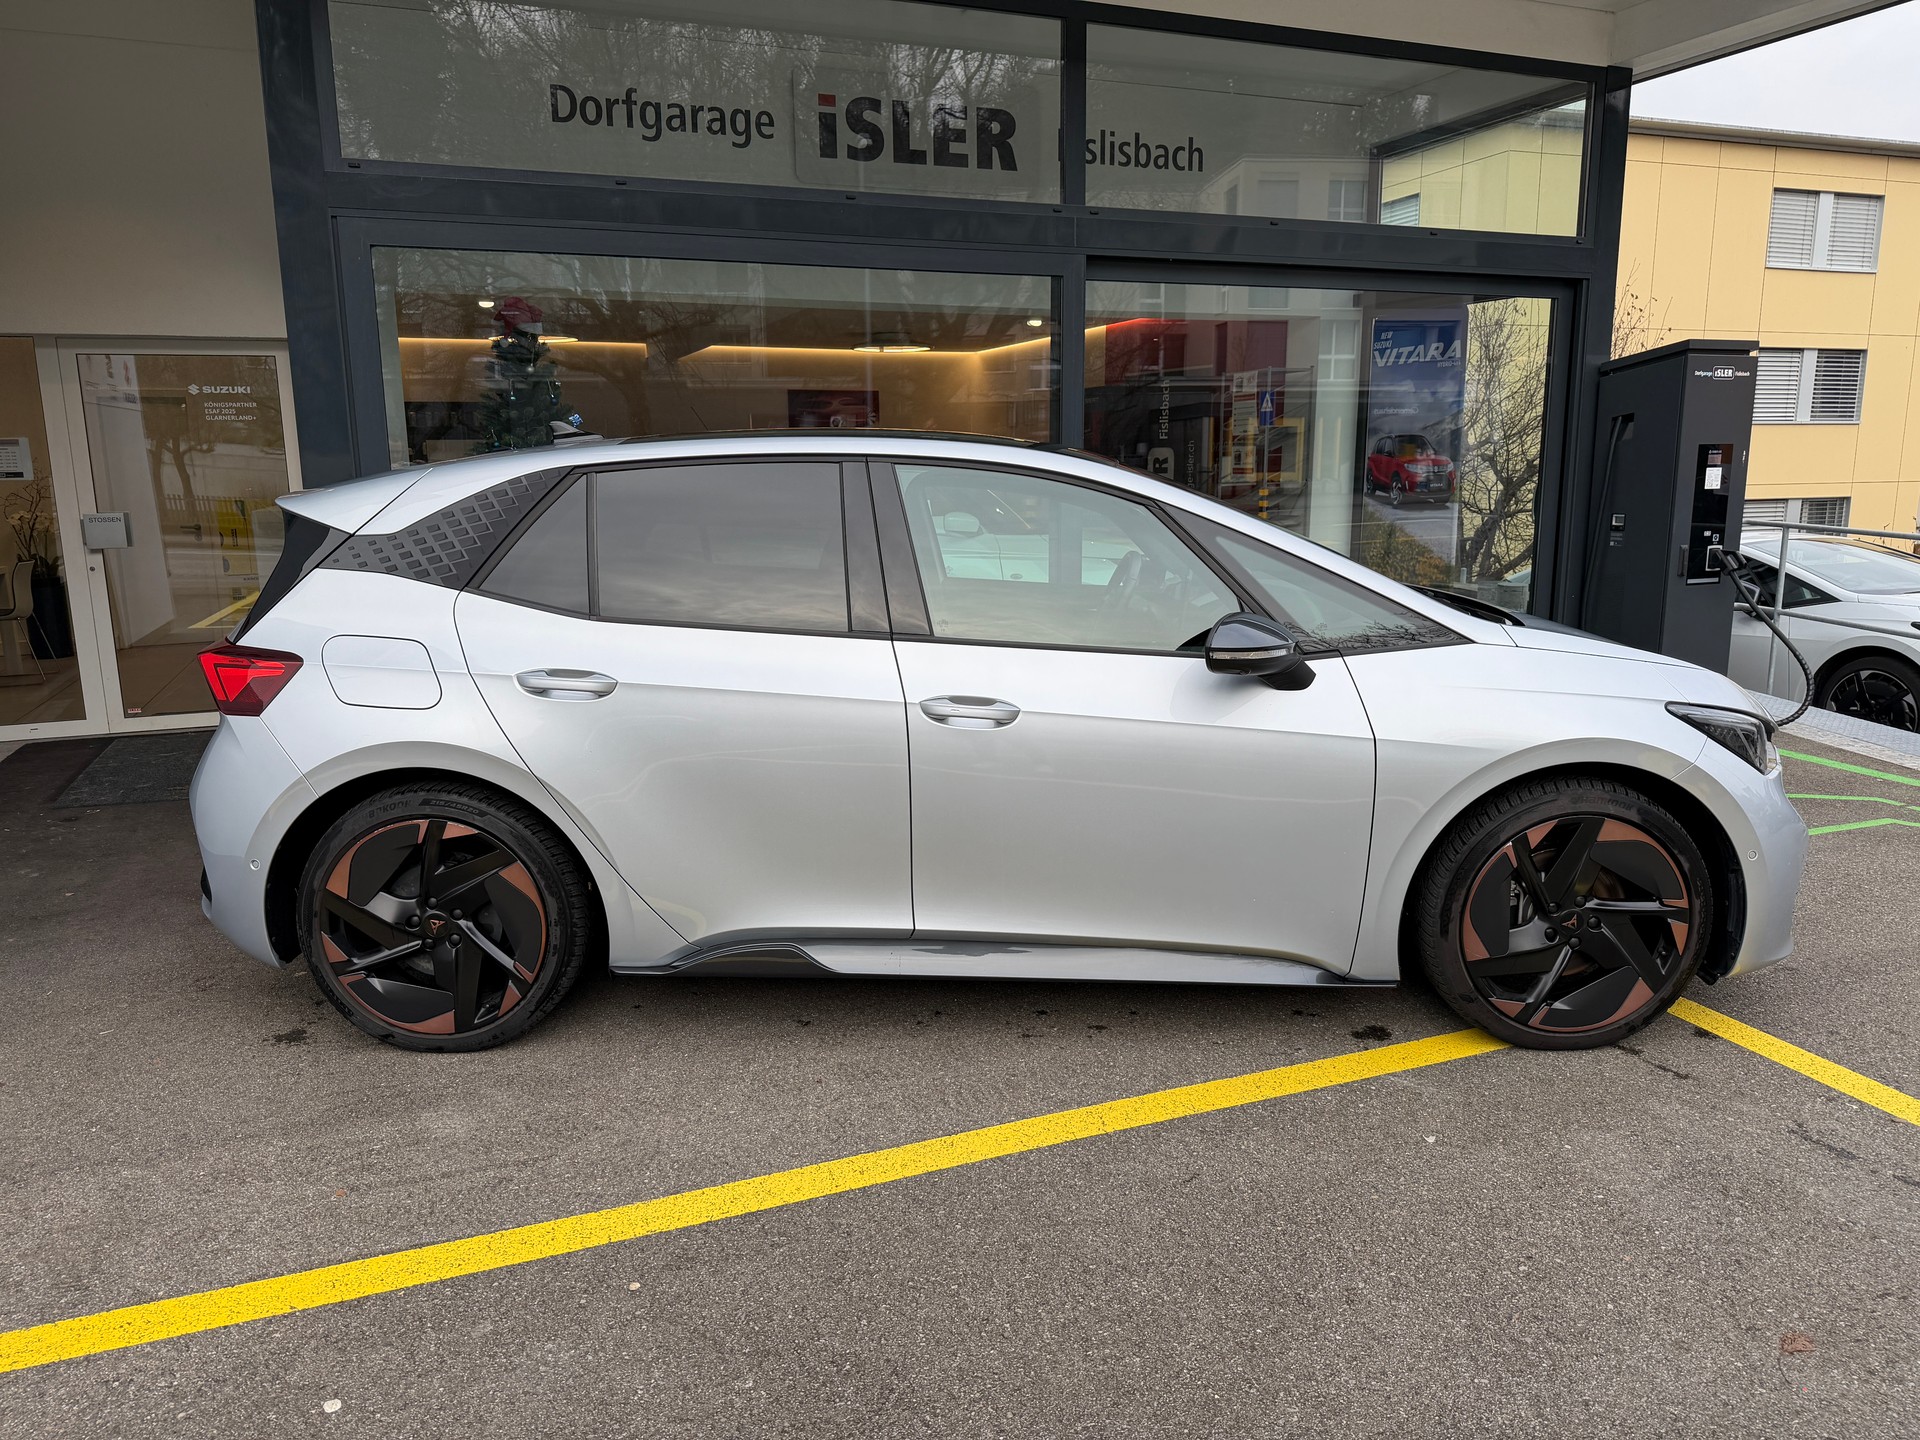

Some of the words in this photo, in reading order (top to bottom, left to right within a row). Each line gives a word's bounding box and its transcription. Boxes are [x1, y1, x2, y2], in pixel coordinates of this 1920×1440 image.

[550, 84, 775, 149] Dorfgarage
[1058, 129, 1204, 173] slisbach
[1373, 339, 1462, 368] VITARA
[202, 385, 251, 394] SUZUKI
[1159, 379, 1170, 439] Fislisbach
[88, 516, 122, 524] STOSSEN
